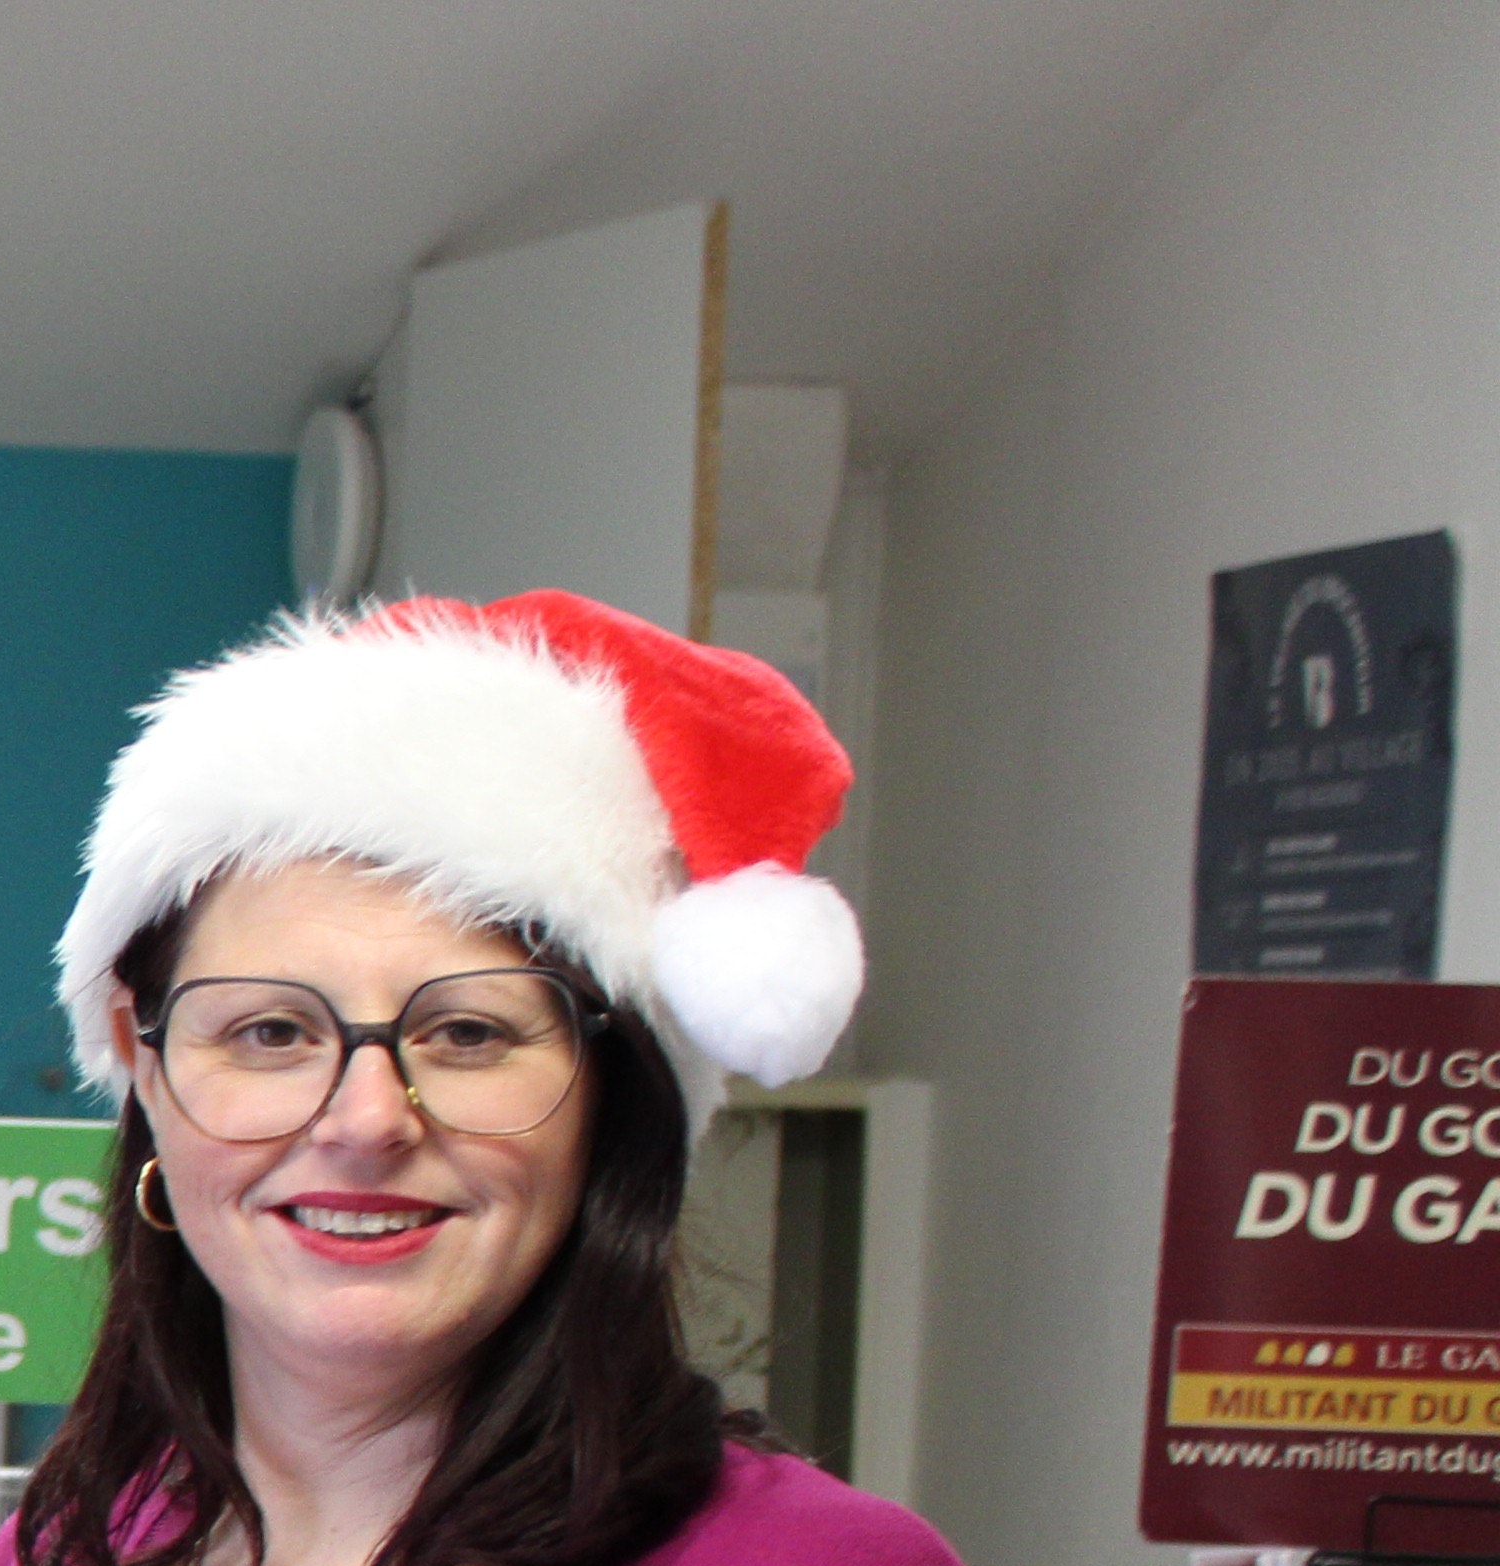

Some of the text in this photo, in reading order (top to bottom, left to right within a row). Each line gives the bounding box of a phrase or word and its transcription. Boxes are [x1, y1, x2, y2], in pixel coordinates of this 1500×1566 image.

[1348, 1046, 1432, 1088] DU
[1295, 1101, 1408, 1155] DU
[1235, 1172, 1500, 1245] DU GA
[1376, 1342, 1427, 1370] LE
[1206, 1386, 1397, 1423] MILITANT
[1411, 1392, 1469, 1425] DU
